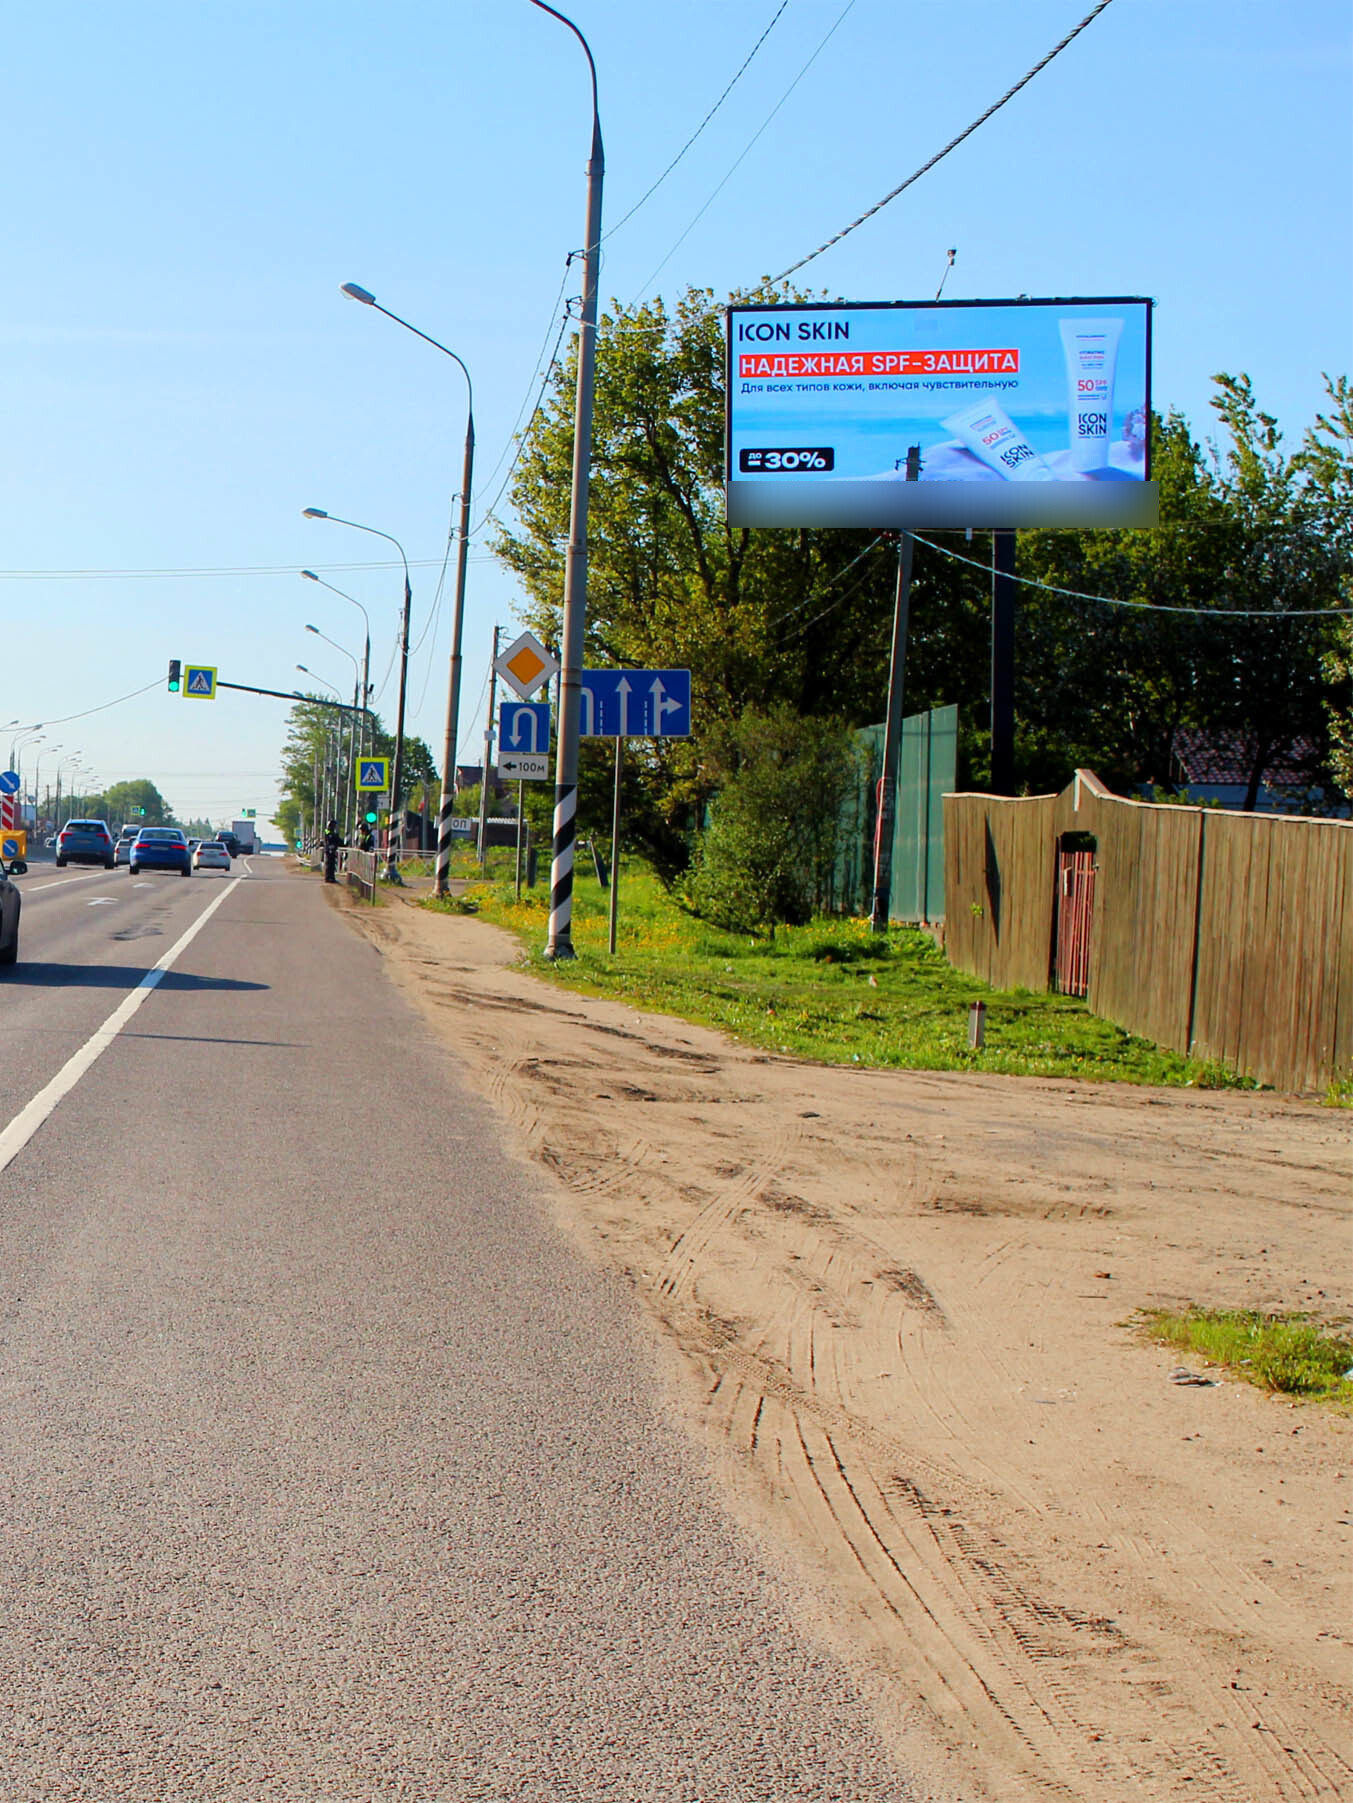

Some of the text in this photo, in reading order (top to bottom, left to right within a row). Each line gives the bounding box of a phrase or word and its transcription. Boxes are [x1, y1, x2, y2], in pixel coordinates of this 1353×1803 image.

[739, 321, 849, 342] ICON SKIN
[741, 353, 1017, 377] НАДЕЖНАЯ SPF-ЗАЩИТА
[741, 380, 1018, 394] Для всех типов кожи, включая чувствительную
[1077, 379, 1095, 391] 50
[1078, 413, 1107, 424] ICON
[1078, 425, 1107, 435] SKIN
